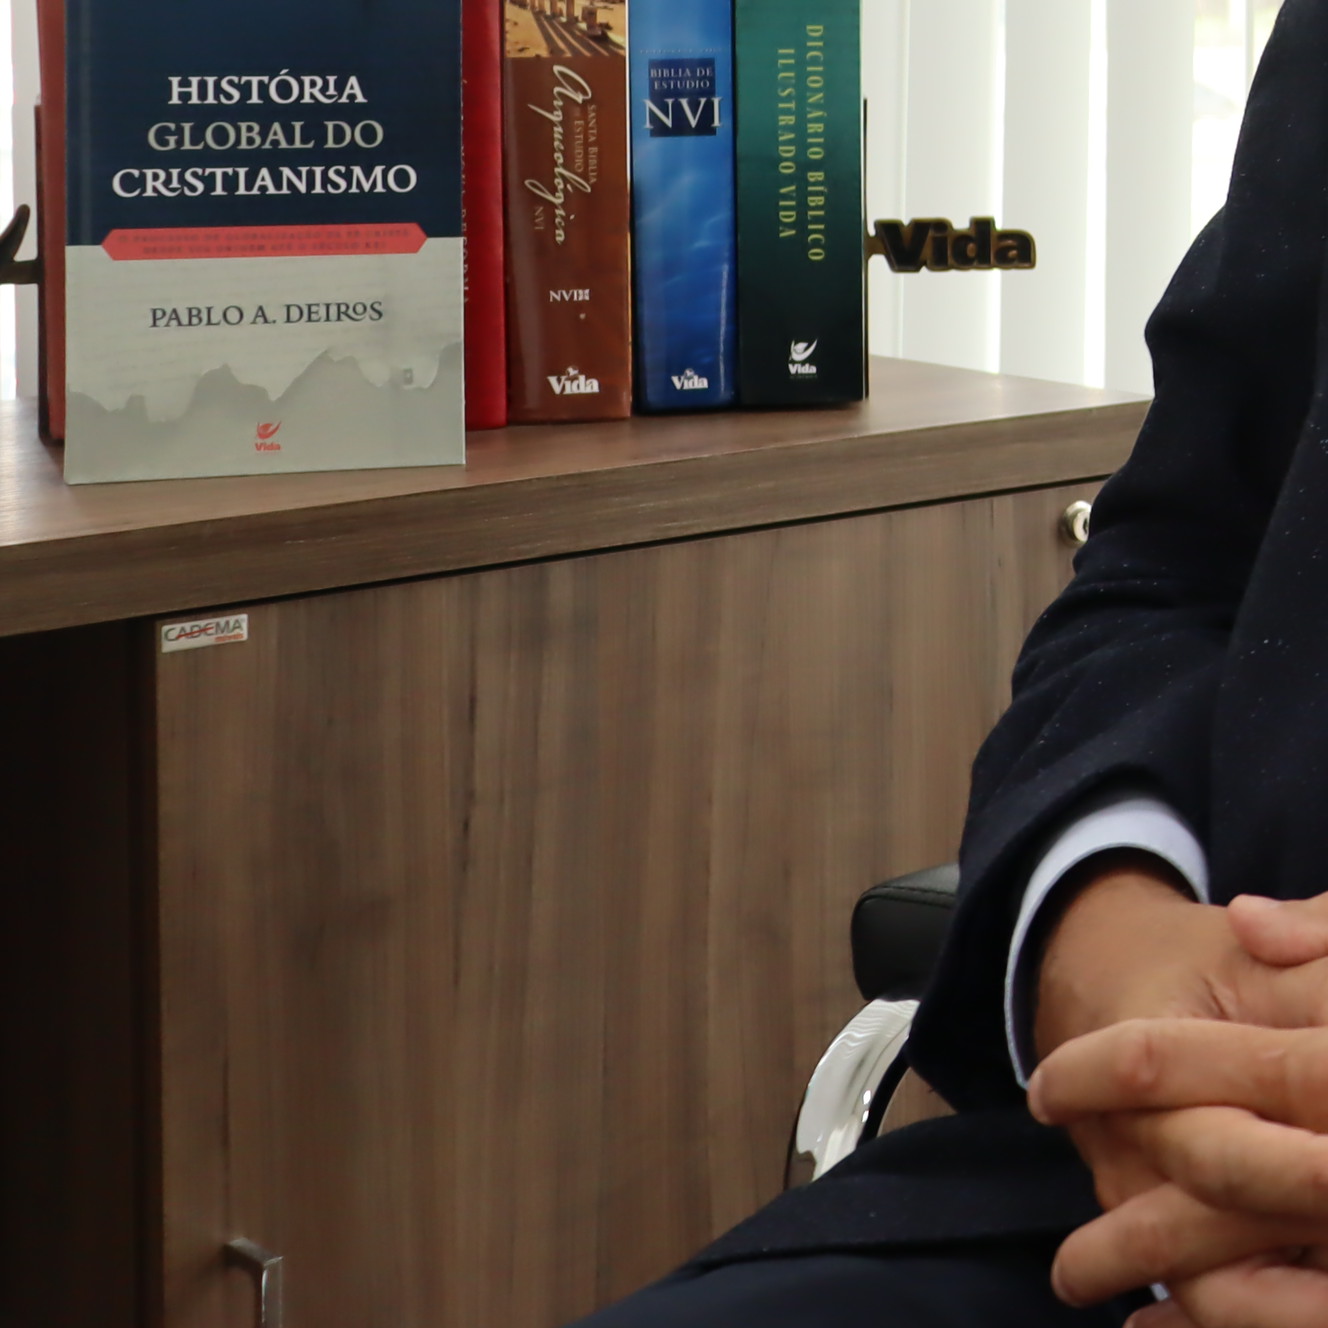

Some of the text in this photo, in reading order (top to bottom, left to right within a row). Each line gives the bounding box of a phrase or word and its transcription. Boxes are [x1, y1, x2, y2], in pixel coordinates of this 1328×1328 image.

[650, 66, 713, 78] BIBLIA DE
[654, 79, 710, 90] ESTUDIO
[168, 69, 368, 104] HISTÓRIA
[587, 104, 597, 143] SANTA
[643, 96, 723, 129] NVI
[148, 120, 384, 151] GLOBAL DO
[574, 120, 585, 173] ESTUDIO
[778, 48, 796, 238] ILUSTRADO VIDA
[806, 25, 828, 261] DICIONÁRIO BÍBLICO
[112, 164, 417, 198] CRISTIANISMO
[534, 206, 544, 230] NVI
[874, 216, 1036, 273] Vida
[150, 305, 244, 328] PABLO
[250, 305, 277, 325] A.
[671, 374, 709, 390] Vida
[788, 363, 817, 375] Vida
[547, 373, 600, 395] Vida
[255, 441, 281, 452] Vida
[164, 618, 244, 642] CADEMA
